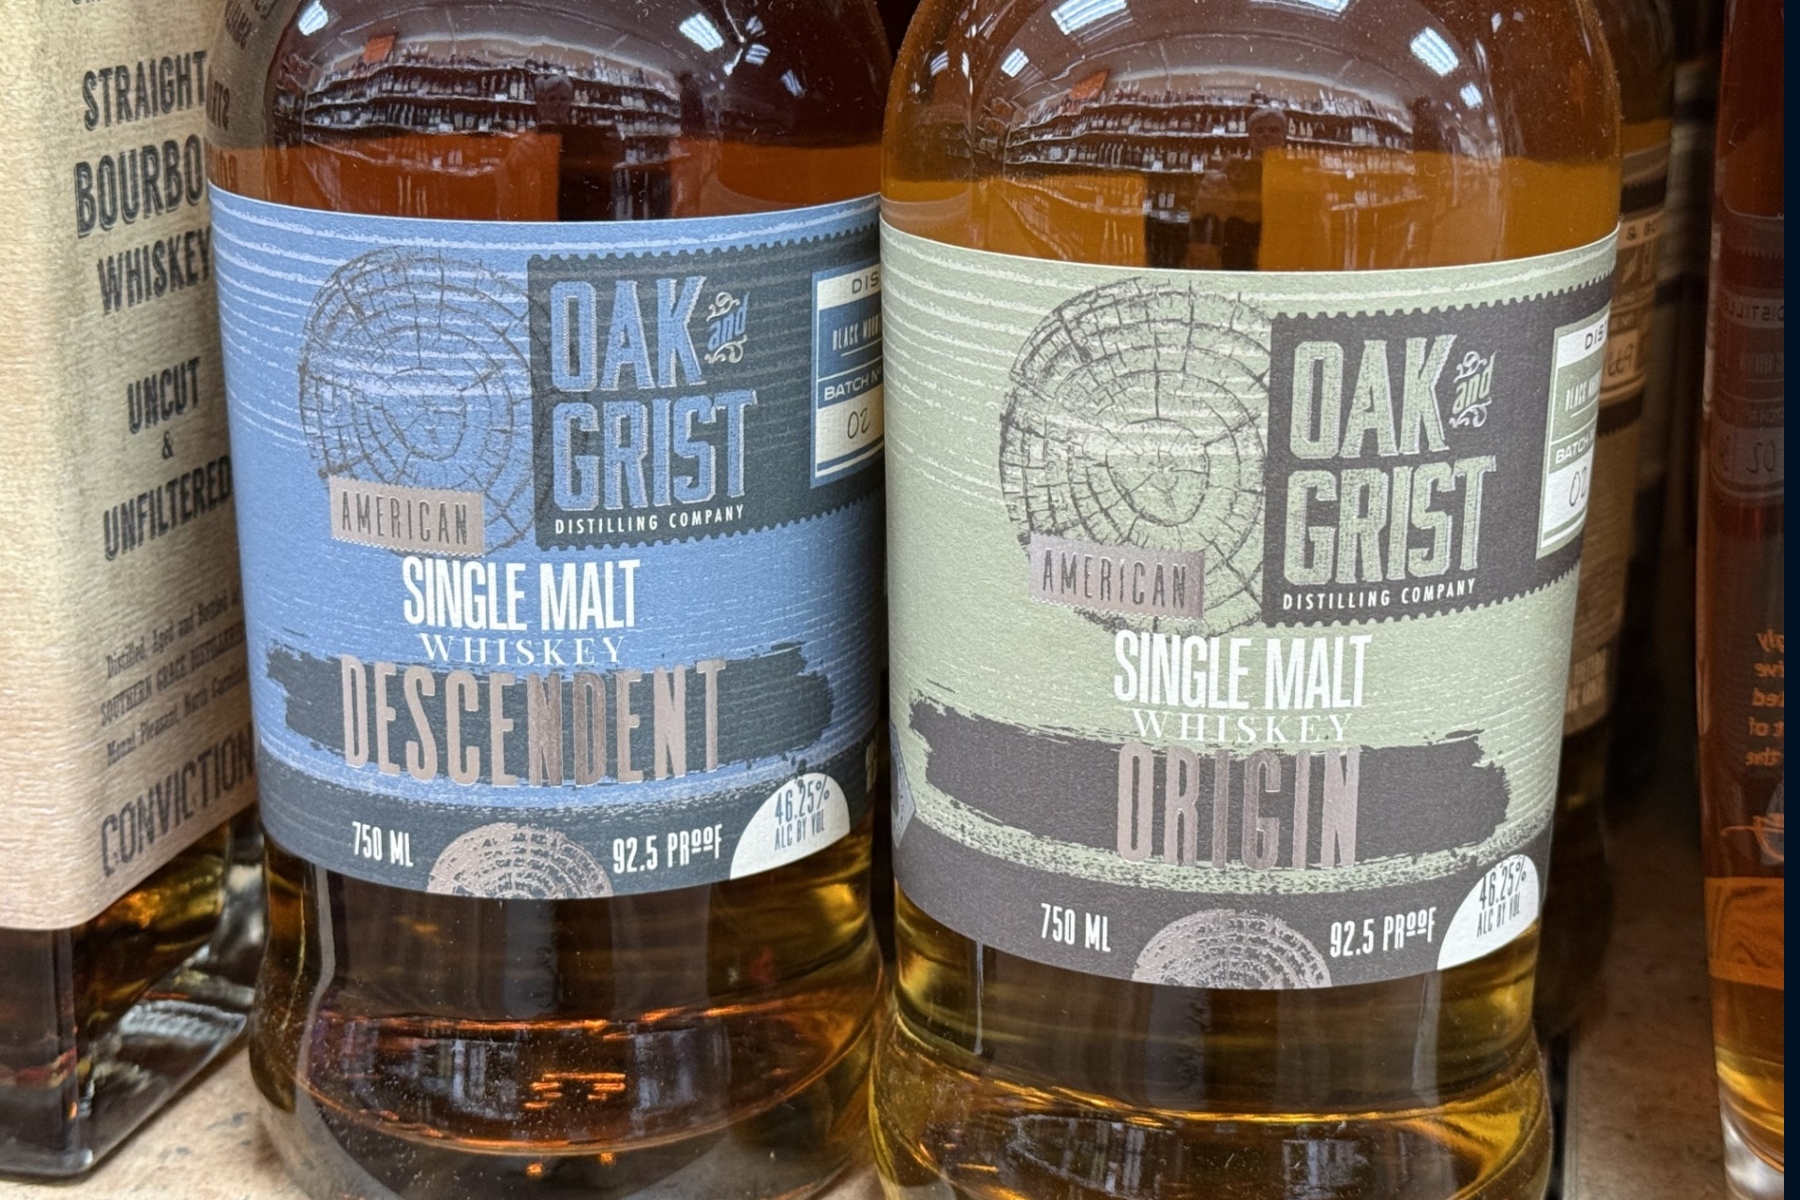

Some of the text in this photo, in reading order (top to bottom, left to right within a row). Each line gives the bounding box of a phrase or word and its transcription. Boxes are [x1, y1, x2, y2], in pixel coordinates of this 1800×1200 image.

[82, 51, 206, 131] STRAIGHT
[97, 225, 211, 314] WHISKEY
[550, 276, 750, 392] OAK and
[127, 356, 200, 434] UNCUT
[824, 373, 869, 402] BATCH
[1289, 334, 1497, 460] OAK and
[162, 430, 175, 459] &
[552, 390, 758, 512] GRIST
[104, 454, 231, 561] UNFILTERED
[341, 490, 468, 546] AMERICAN
[555, 504, 744, 534] DISTILLING COMPANY
[1283, 455, 1497, 586] GRIST
[402, 555, 640, 632] SINGLE MALT
[1043, 548, 1187, 608] AMERICAN
[1283, 577, 1475, 611] DISTILLING COMPANY
[418, 632, 627, 667] WHISKEY
[1114, 629, 1373, 710] SINGLE MALT
[340, 654, 726, 788] DESCENDENT
[1131, 708, 1353, 744] WHISKEY
[101, 722, 253, 878] CONVICTION
[774, 775, 830, 826] 46.25%
[1117, 741, 1362, 871] ORIGIN
[351, 821, 414, 868] 750 ML
[612, 837, 659, 875] 92.5
[774, 808, 825, 851] ALC BY VOL
[1479, 855, 1527, 910] 46.25%
[1040, 902, 1111, 953] 750 ML
[1330, 918, 1375, 959] 92.5
[1477, 908, 1493, 937] ALC
